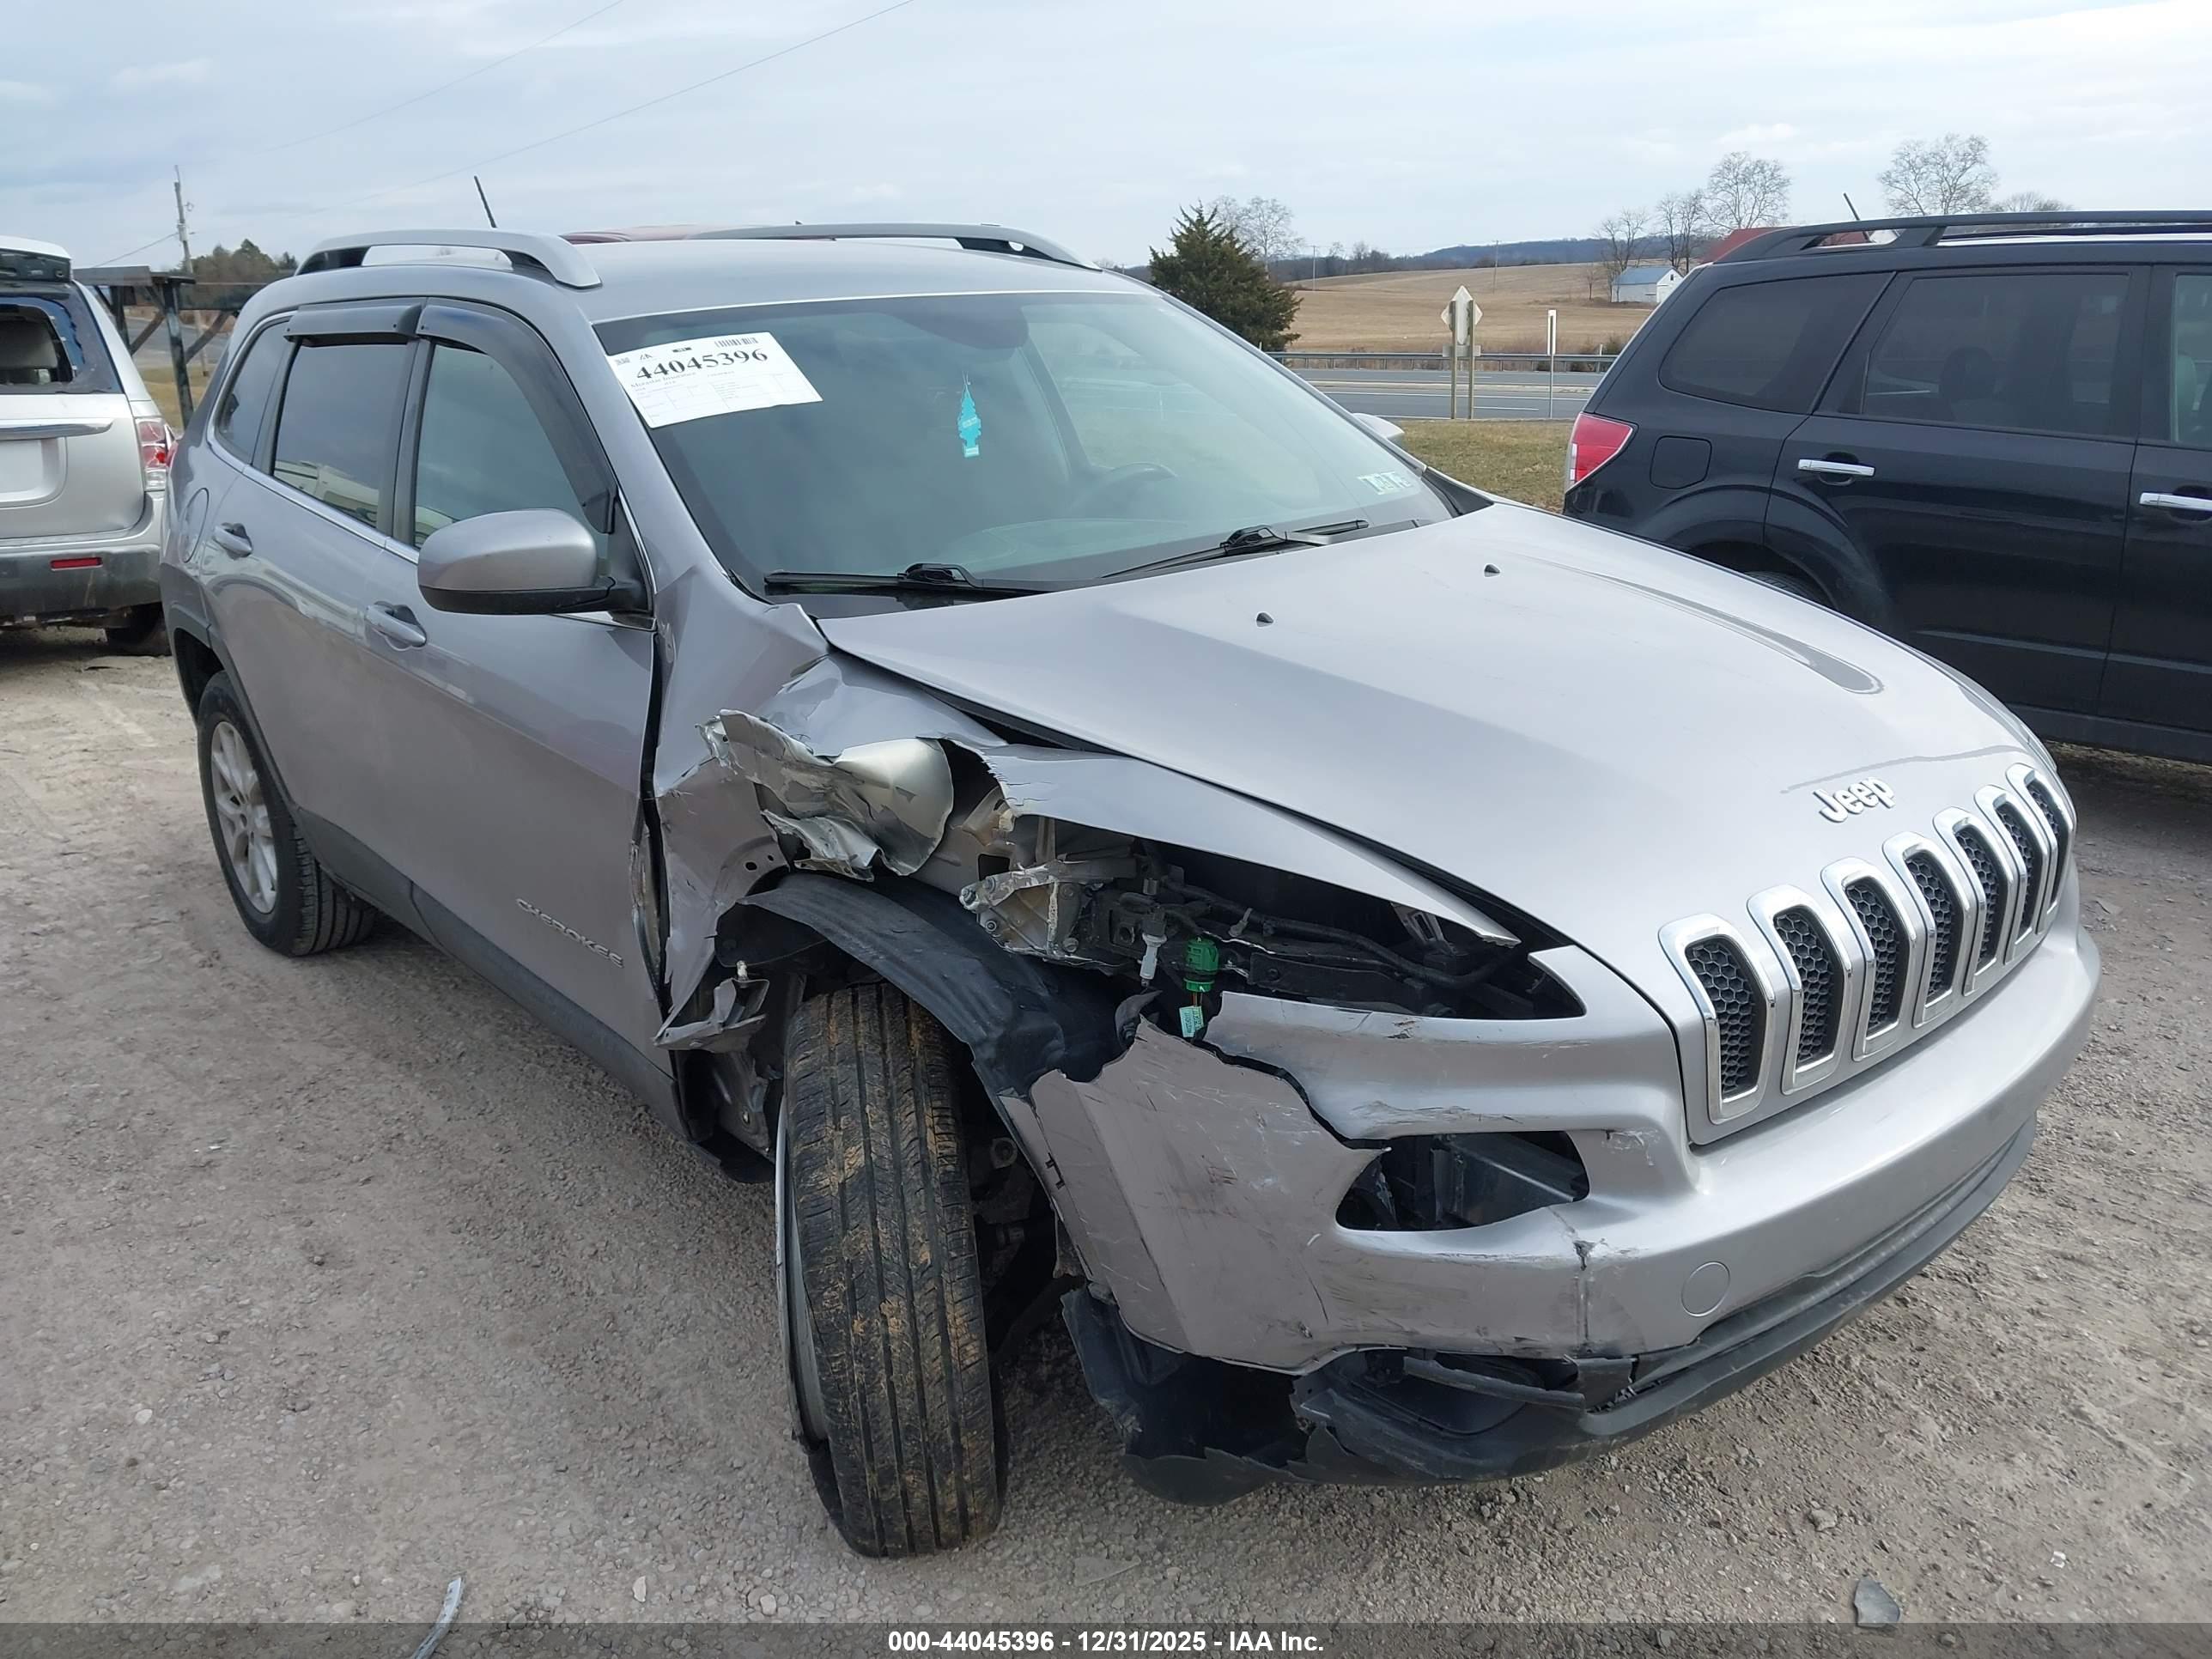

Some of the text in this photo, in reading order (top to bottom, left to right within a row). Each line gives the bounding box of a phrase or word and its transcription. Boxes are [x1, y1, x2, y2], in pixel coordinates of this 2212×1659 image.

[636, 348, 769, 379] 44045396
[1812, 776, 1896, 823] Jeep
[515, 898, 624, 969] CHEROKEE
